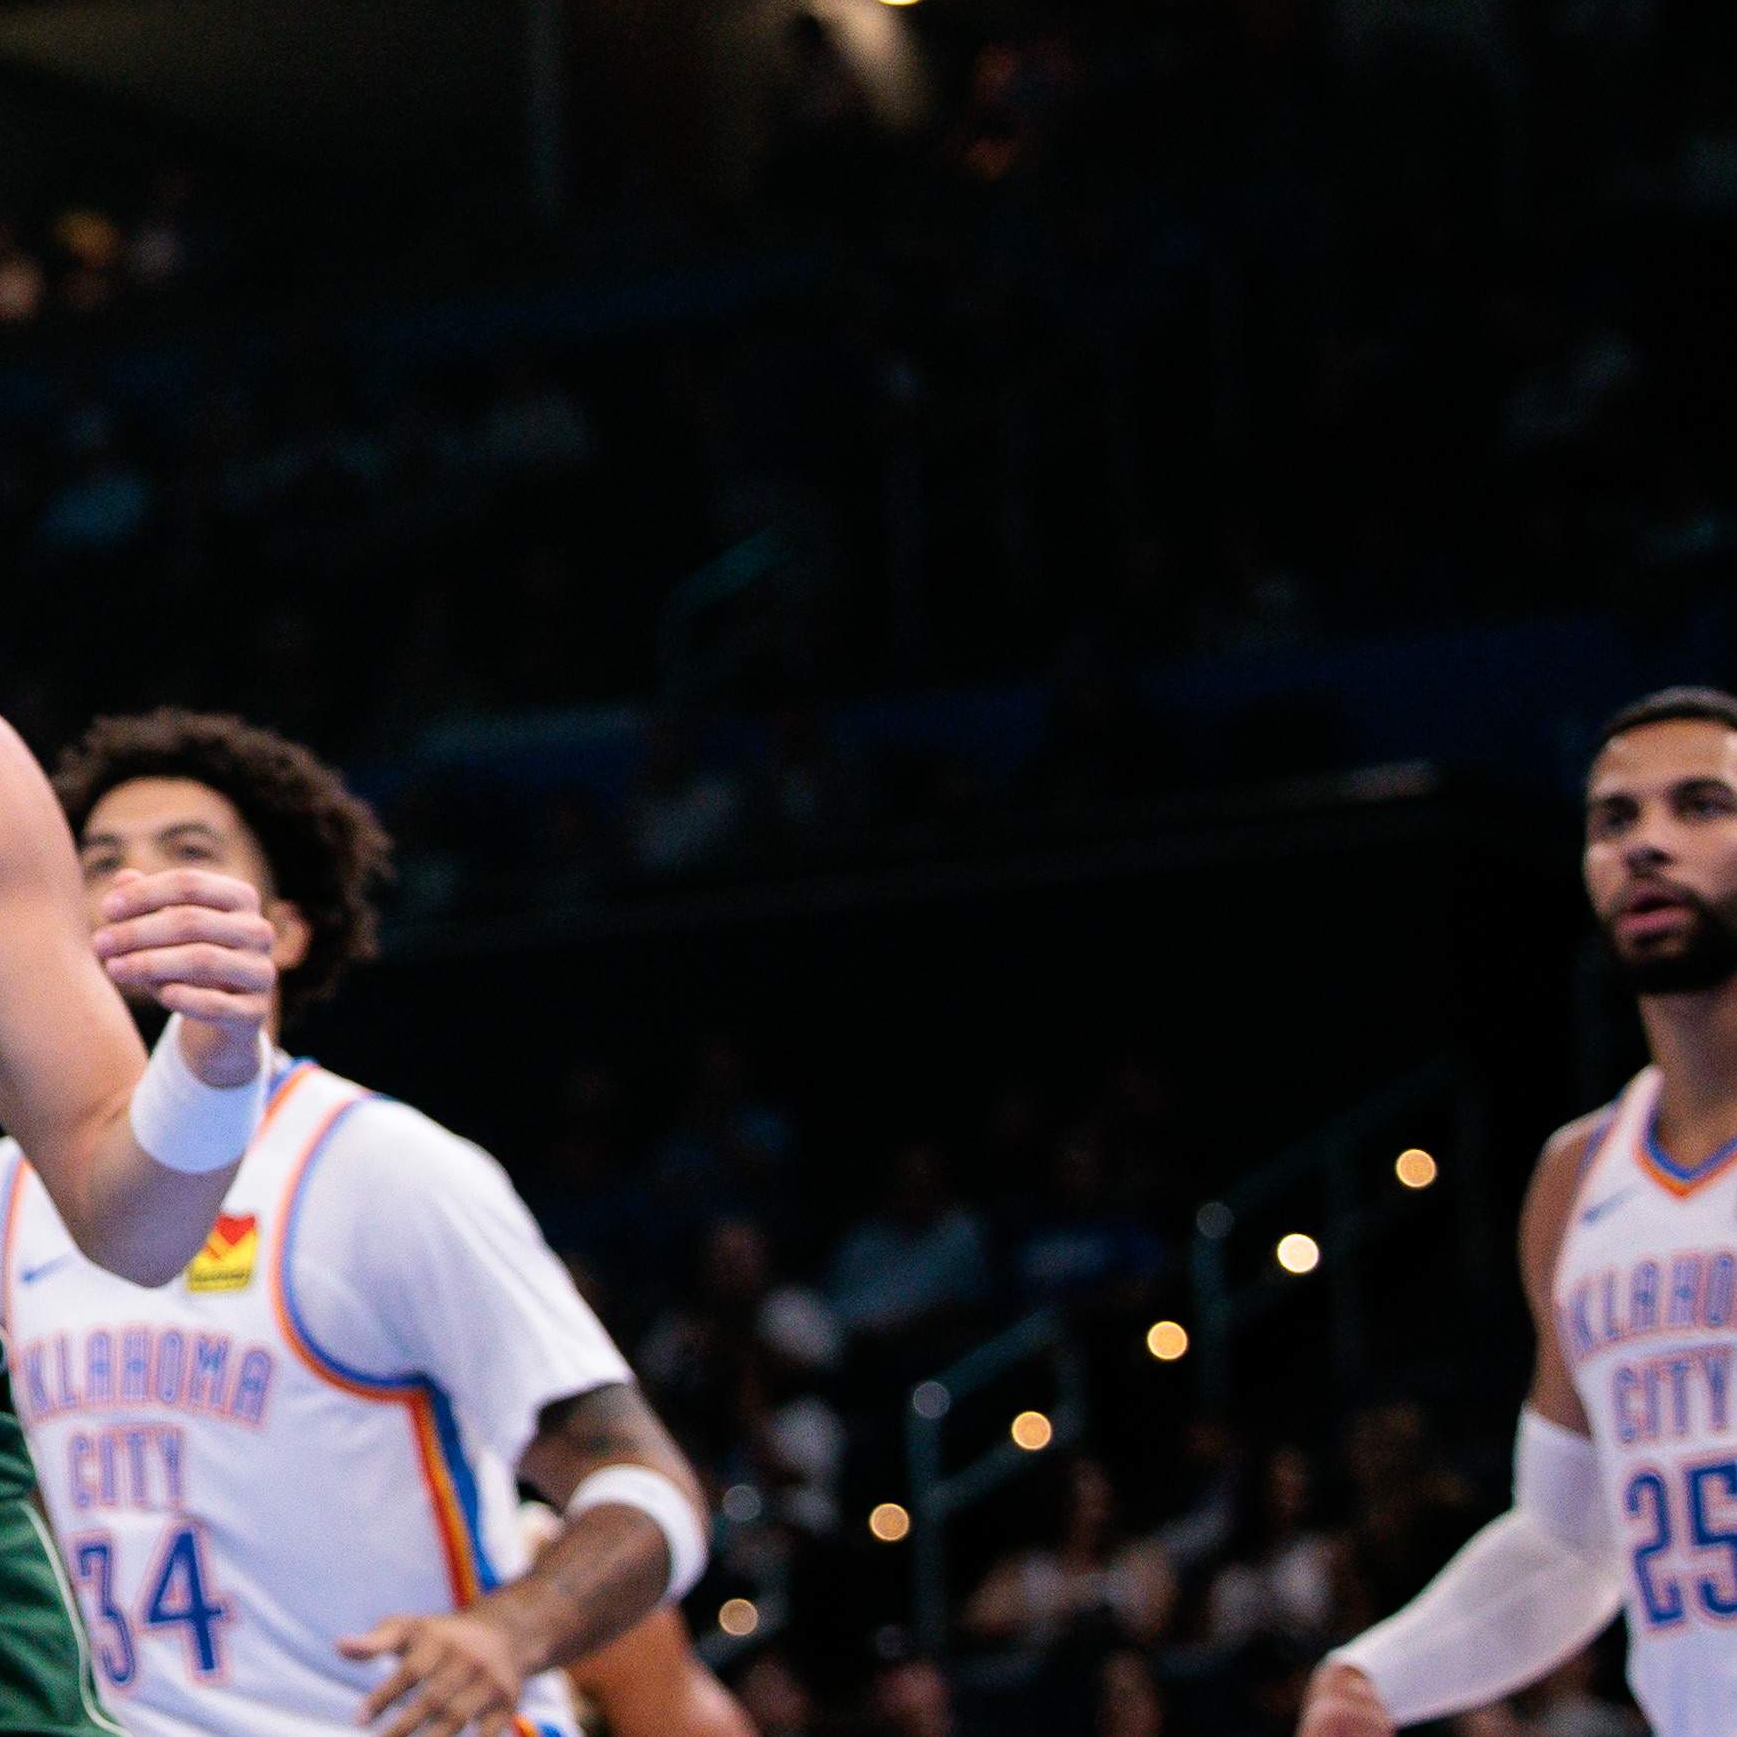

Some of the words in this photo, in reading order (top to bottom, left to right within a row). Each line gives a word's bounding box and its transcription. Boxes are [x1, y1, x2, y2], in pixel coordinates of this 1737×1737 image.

[1612, 1346, 1736, 1445] CITY
[64, 1421, 186, 1513] CITY
[68, 1516, 236, 1693] 34
[1622, 1455, 1737, 1633] 25
